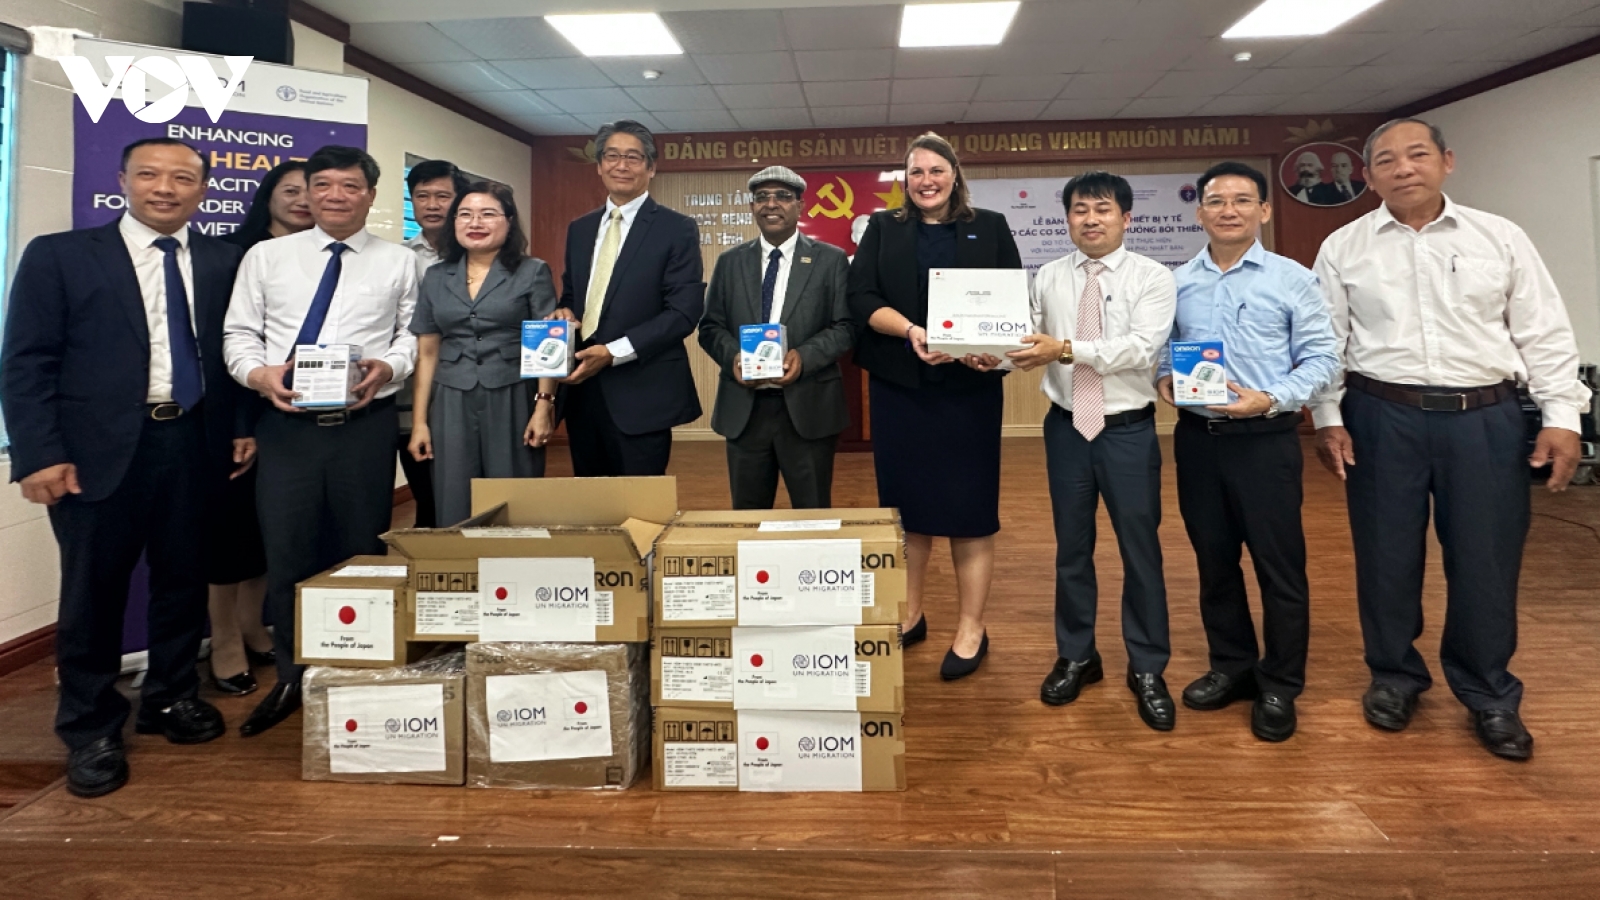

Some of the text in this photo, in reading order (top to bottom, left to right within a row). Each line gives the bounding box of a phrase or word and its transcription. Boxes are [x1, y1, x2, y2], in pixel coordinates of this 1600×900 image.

[168, 124, 294, 148] ENHANCING
[964, 133, 1042, 152] QUANG
[1047, 131, 1100, 149] VINH
[1107, 125, 1177, 148] MUÔN
[664, 136, 726, 160] ĐẢNG
[800, 133, 846, 157] SẢN
[850, 133, 899, 158] VIỆT
[684, 194, 722, 206] TRUNG
[197, 222, 240, 236] VIET
[1019, 228, 1038, 236] CÁC
[996, 322, 1026, 333] IOM
[819, 570, 854, 584] IOM
[555, 587, 588, 601] IOM
[331, 641, 348, 649] People
[813, 654, 848, 669] IOM
[514, 707, 546, 721] IOM
[404, 717, 438, 732] IOM
[819, 736, 854, 751] IOM
